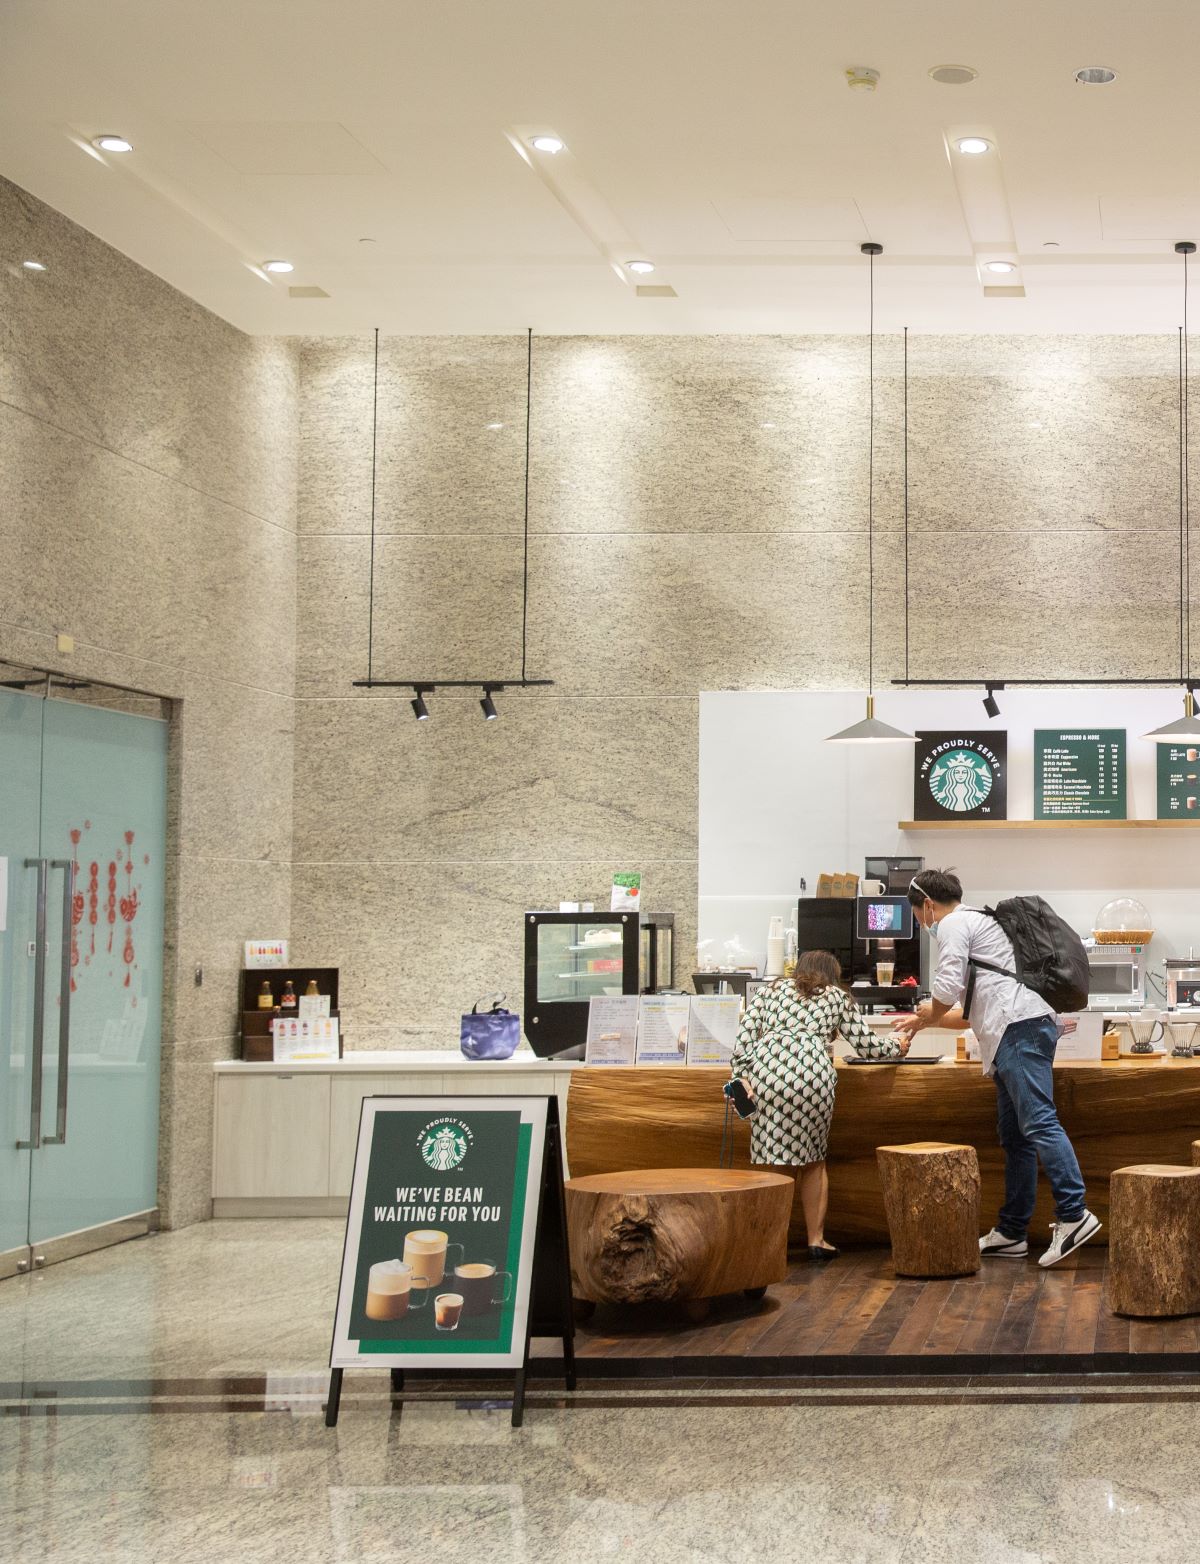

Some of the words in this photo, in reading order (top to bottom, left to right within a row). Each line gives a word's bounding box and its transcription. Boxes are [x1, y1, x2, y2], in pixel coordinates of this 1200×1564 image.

[921, 756, 932, 770] WE
[932, 740, 975, 756] PROUDLY
[977, 744, 1000, 768] SERVE
[416, 1130, 428, 1141] WE
[426, 1117, 458, 1130] PROUDLY
[458, 1120, 474, 1140] SERVE
[444, 1187, 483, 1203] BEAN
[374, 1206, 437, 1222] WAITING
[440, 1206, 467, 1222] FOR
[472, 1206, 501, 1222] YOU
